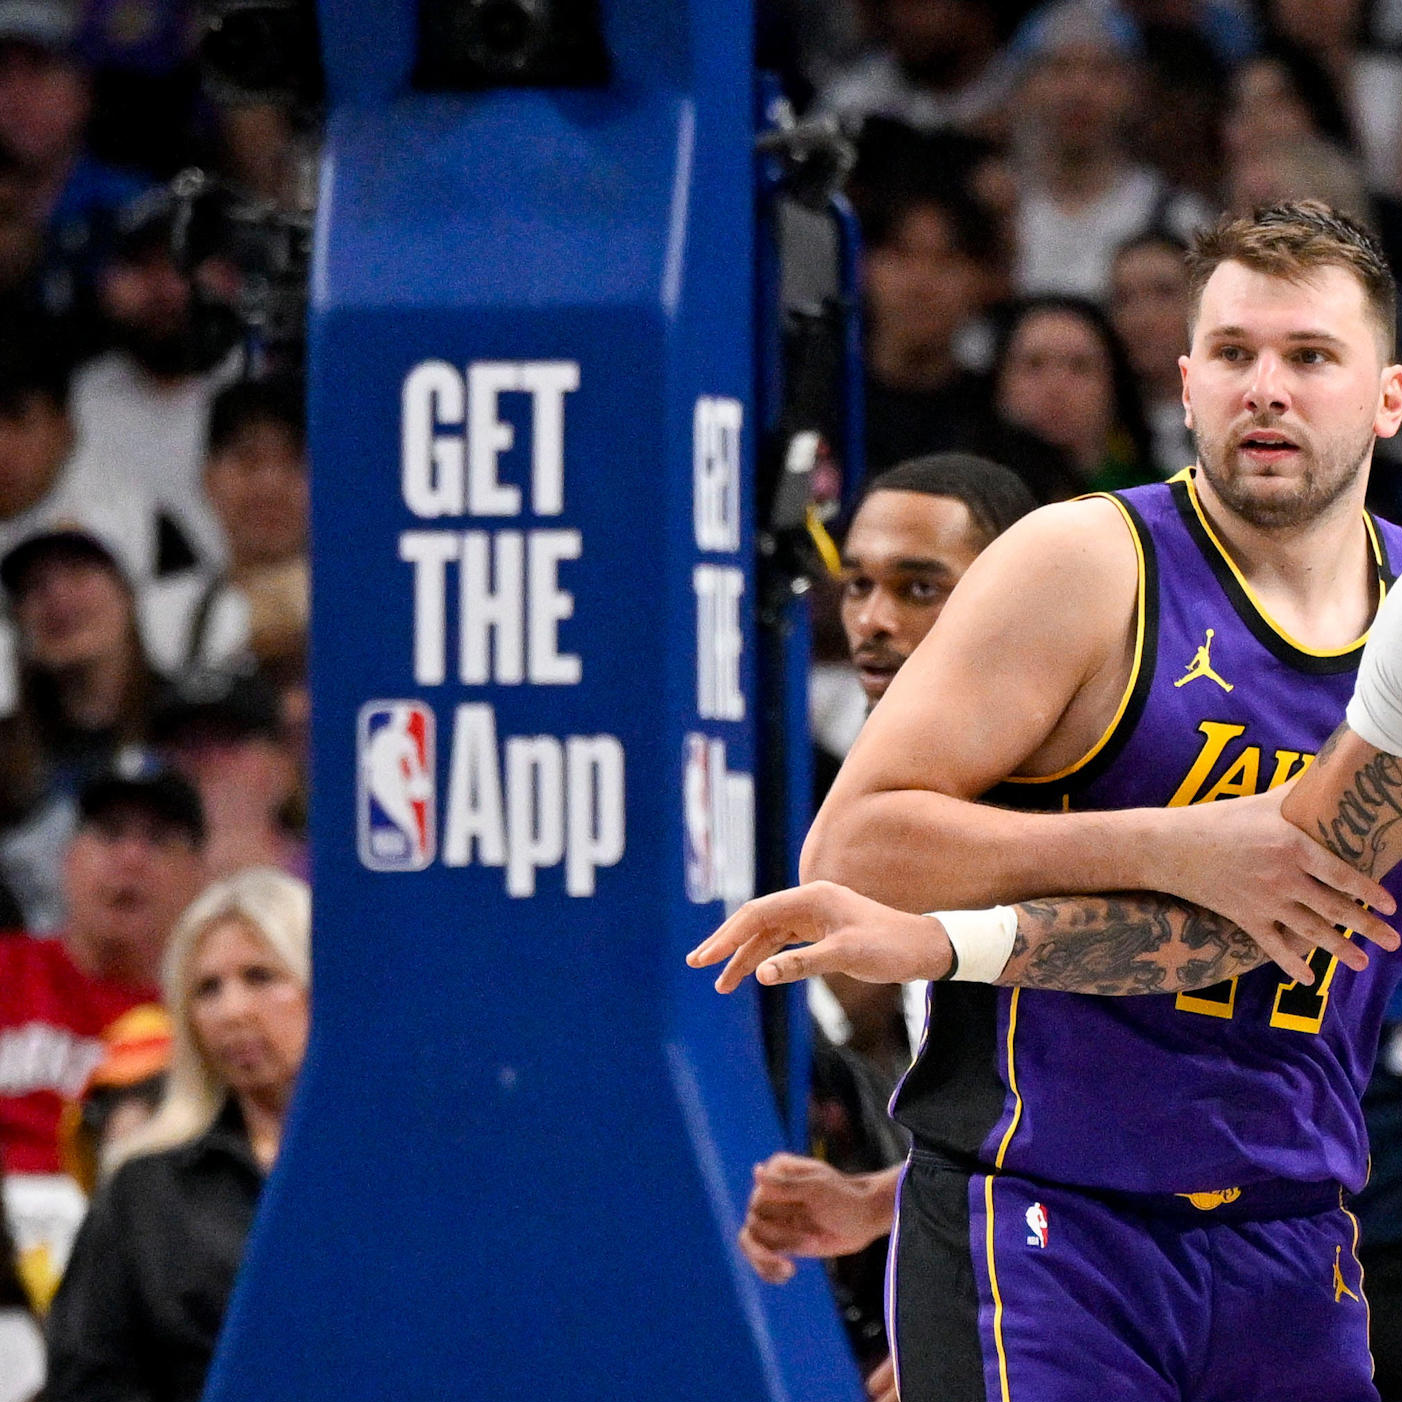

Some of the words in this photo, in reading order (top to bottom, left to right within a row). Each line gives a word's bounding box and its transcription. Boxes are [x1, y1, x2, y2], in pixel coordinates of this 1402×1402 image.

[402, 361, 580, 517] GET
[400, 531, 582, 685] THE
[442, 702, 626, 898] App
